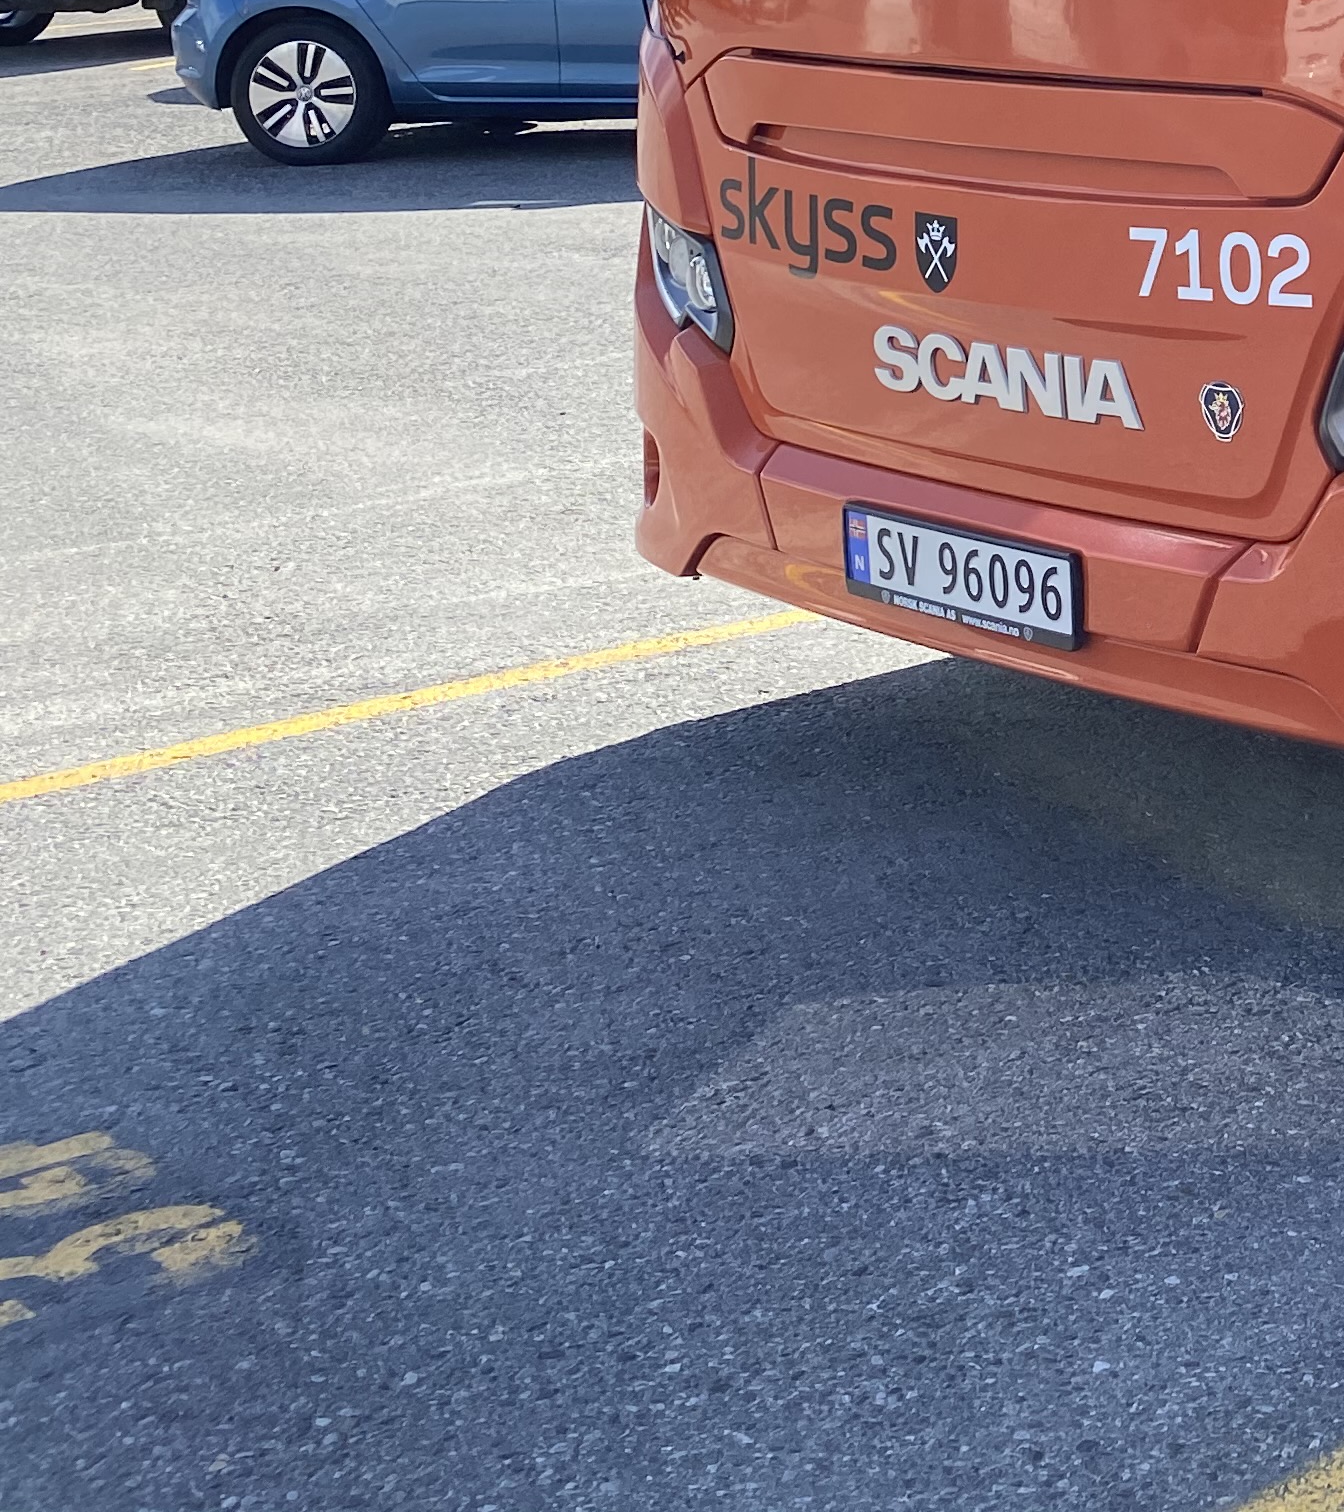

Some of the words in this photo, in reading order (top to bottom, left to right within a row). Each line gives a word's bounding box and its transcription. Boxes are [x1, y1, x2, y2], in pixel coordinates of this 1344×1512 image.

[719, 157, 897, 278] skyss
[1128, 227, 1314, 309] 7102
[873, 324, 1145, 431] SCANIA
[854, 554, 865, 571] N
[877, 527, 918, 586] SV
[938, 542, 1062, 621] 96096
